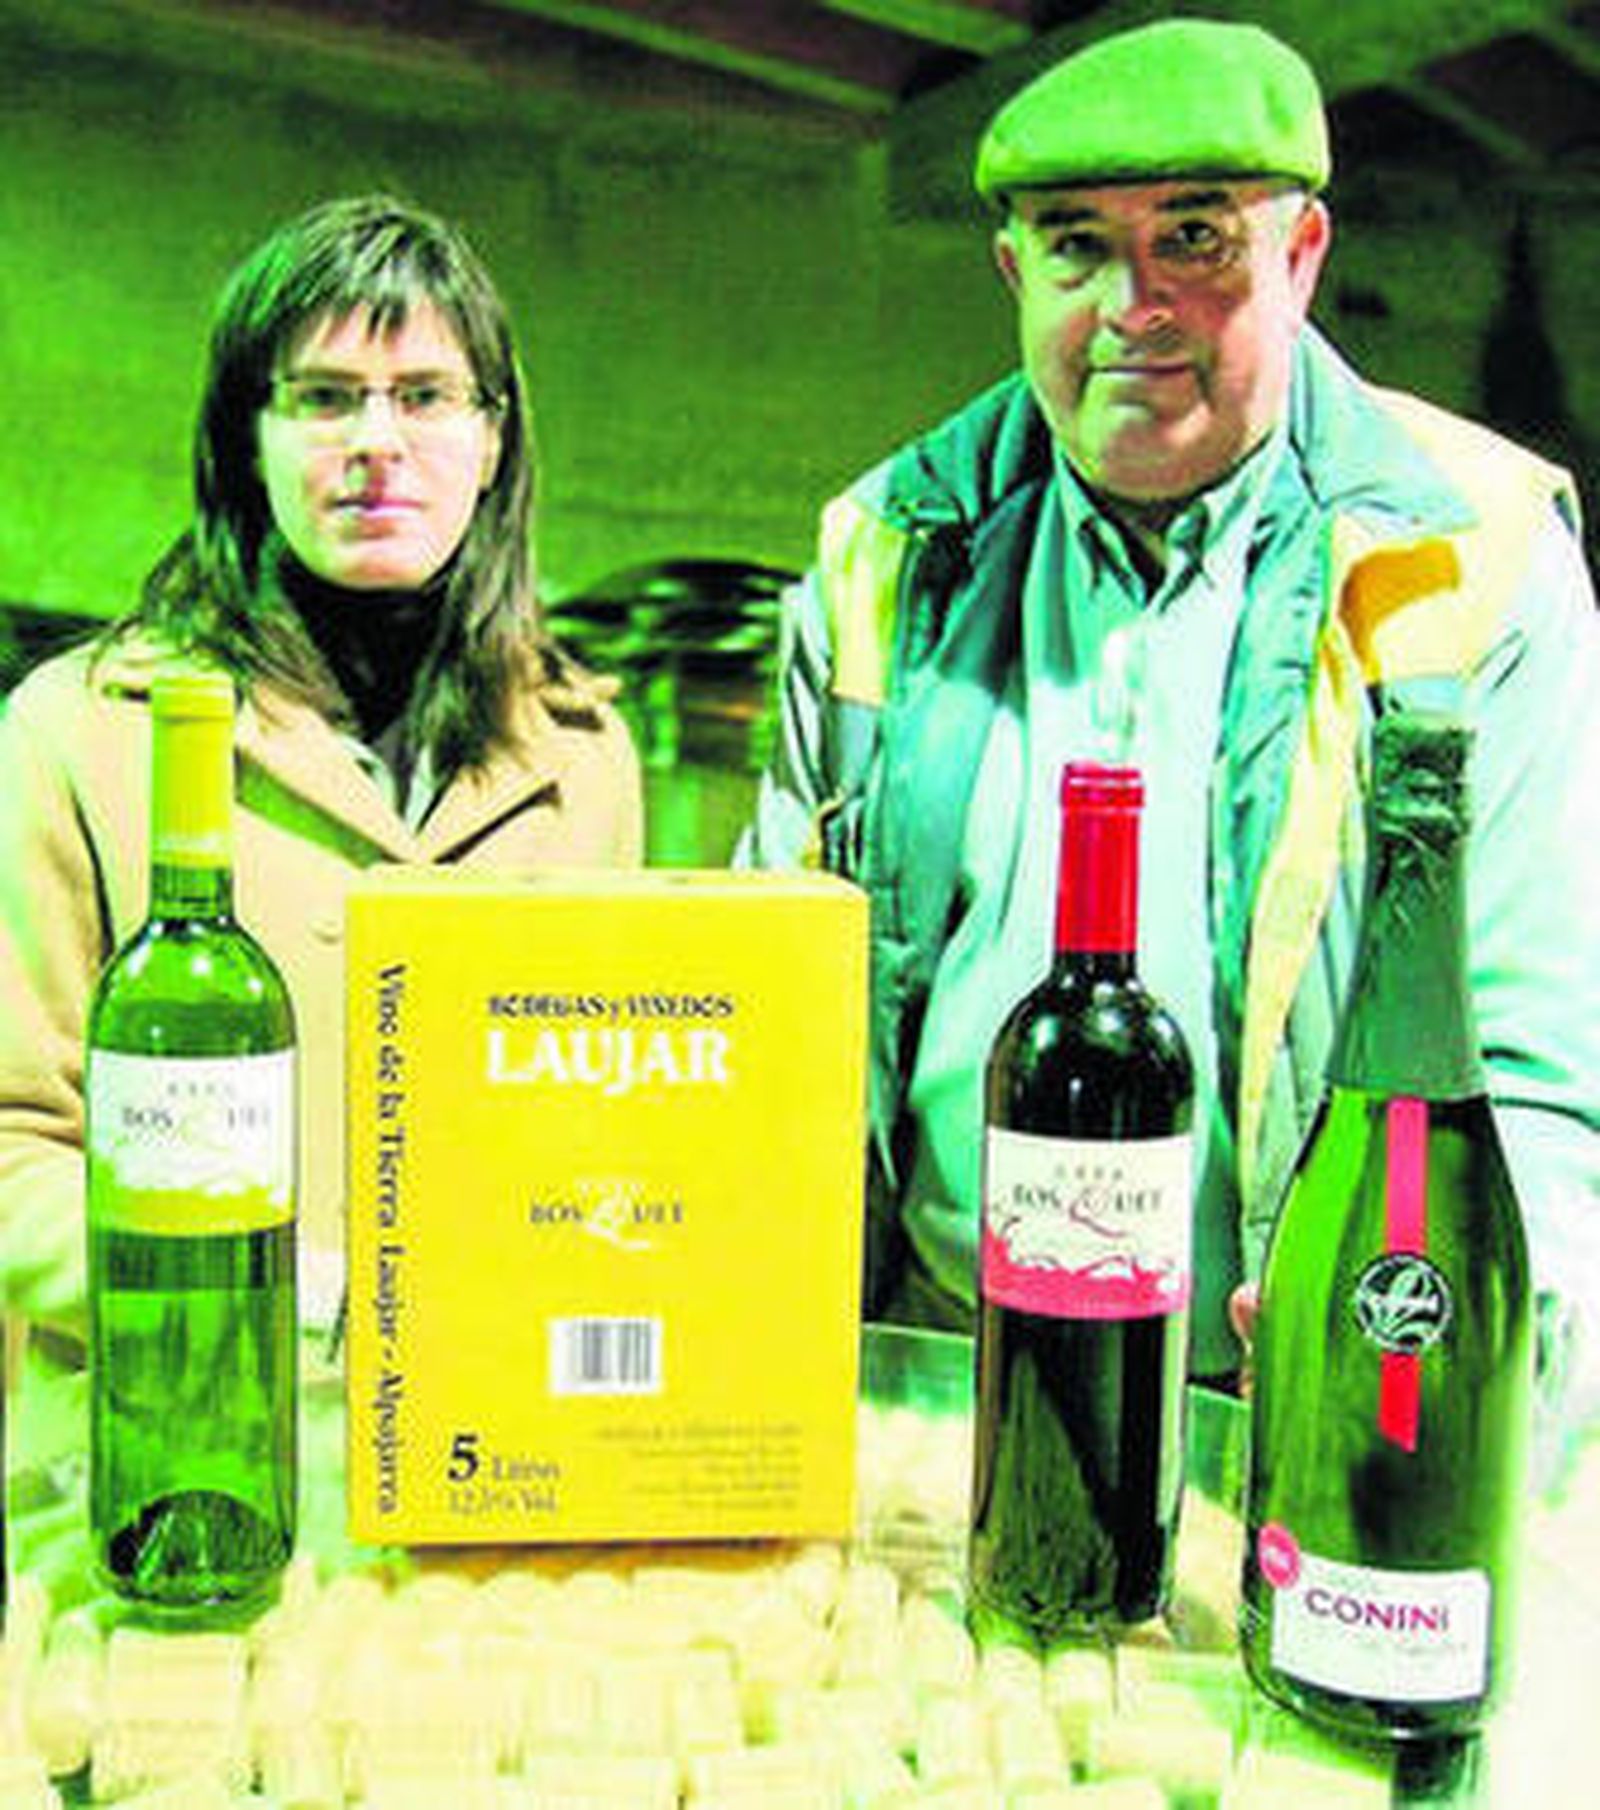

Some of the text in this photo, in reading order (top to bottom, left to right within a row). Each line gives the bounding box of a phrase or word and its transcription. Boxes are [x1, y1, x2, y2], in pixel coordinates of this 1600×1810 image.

[488, 993, 605, 1018] BODEGAS
[486, 1028, 732, 1096] LAUJAR
[447, 1433, 480, 1482] 5
